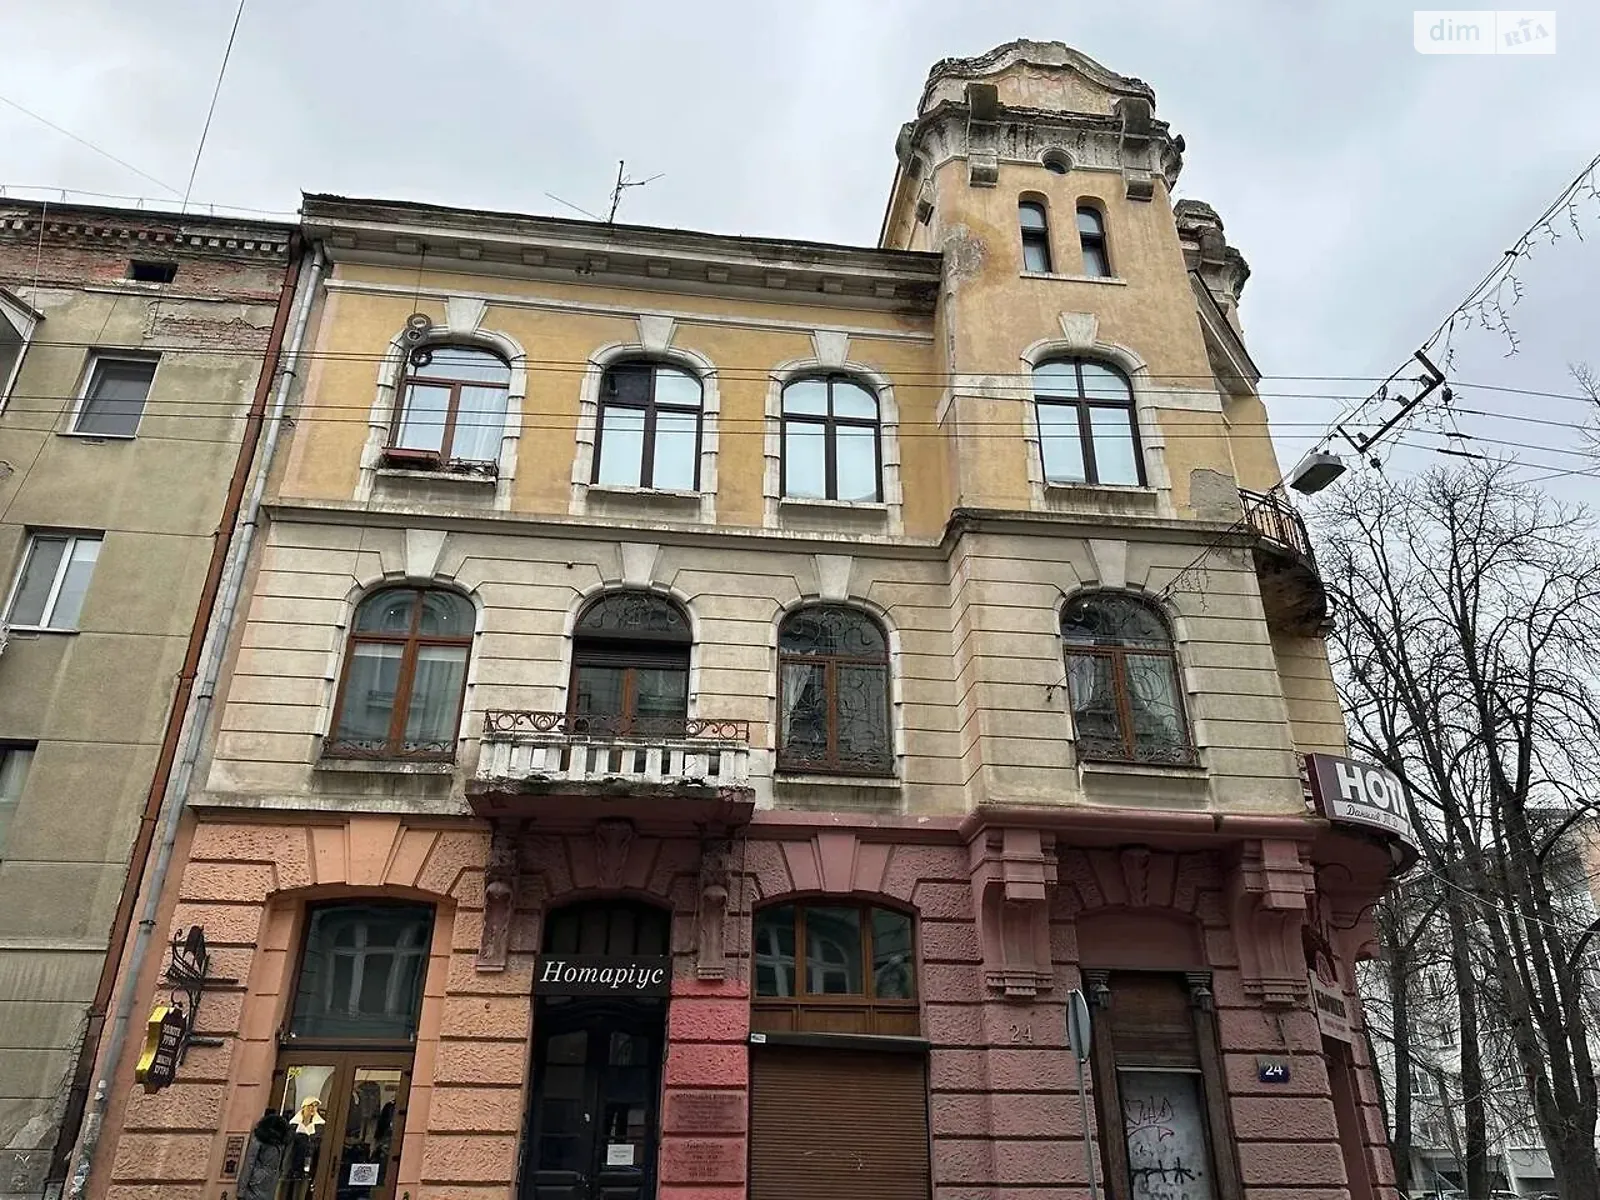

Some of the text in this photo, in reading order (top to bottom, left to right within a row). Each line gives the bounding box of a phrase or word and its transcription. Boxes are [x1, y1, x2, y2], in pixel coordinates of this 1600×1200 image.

[540, 960, 665, 990] Нотаріус
[1009, 1024, 1033, 1043] 24
[1265, 1064, 1284, 1076] 24
